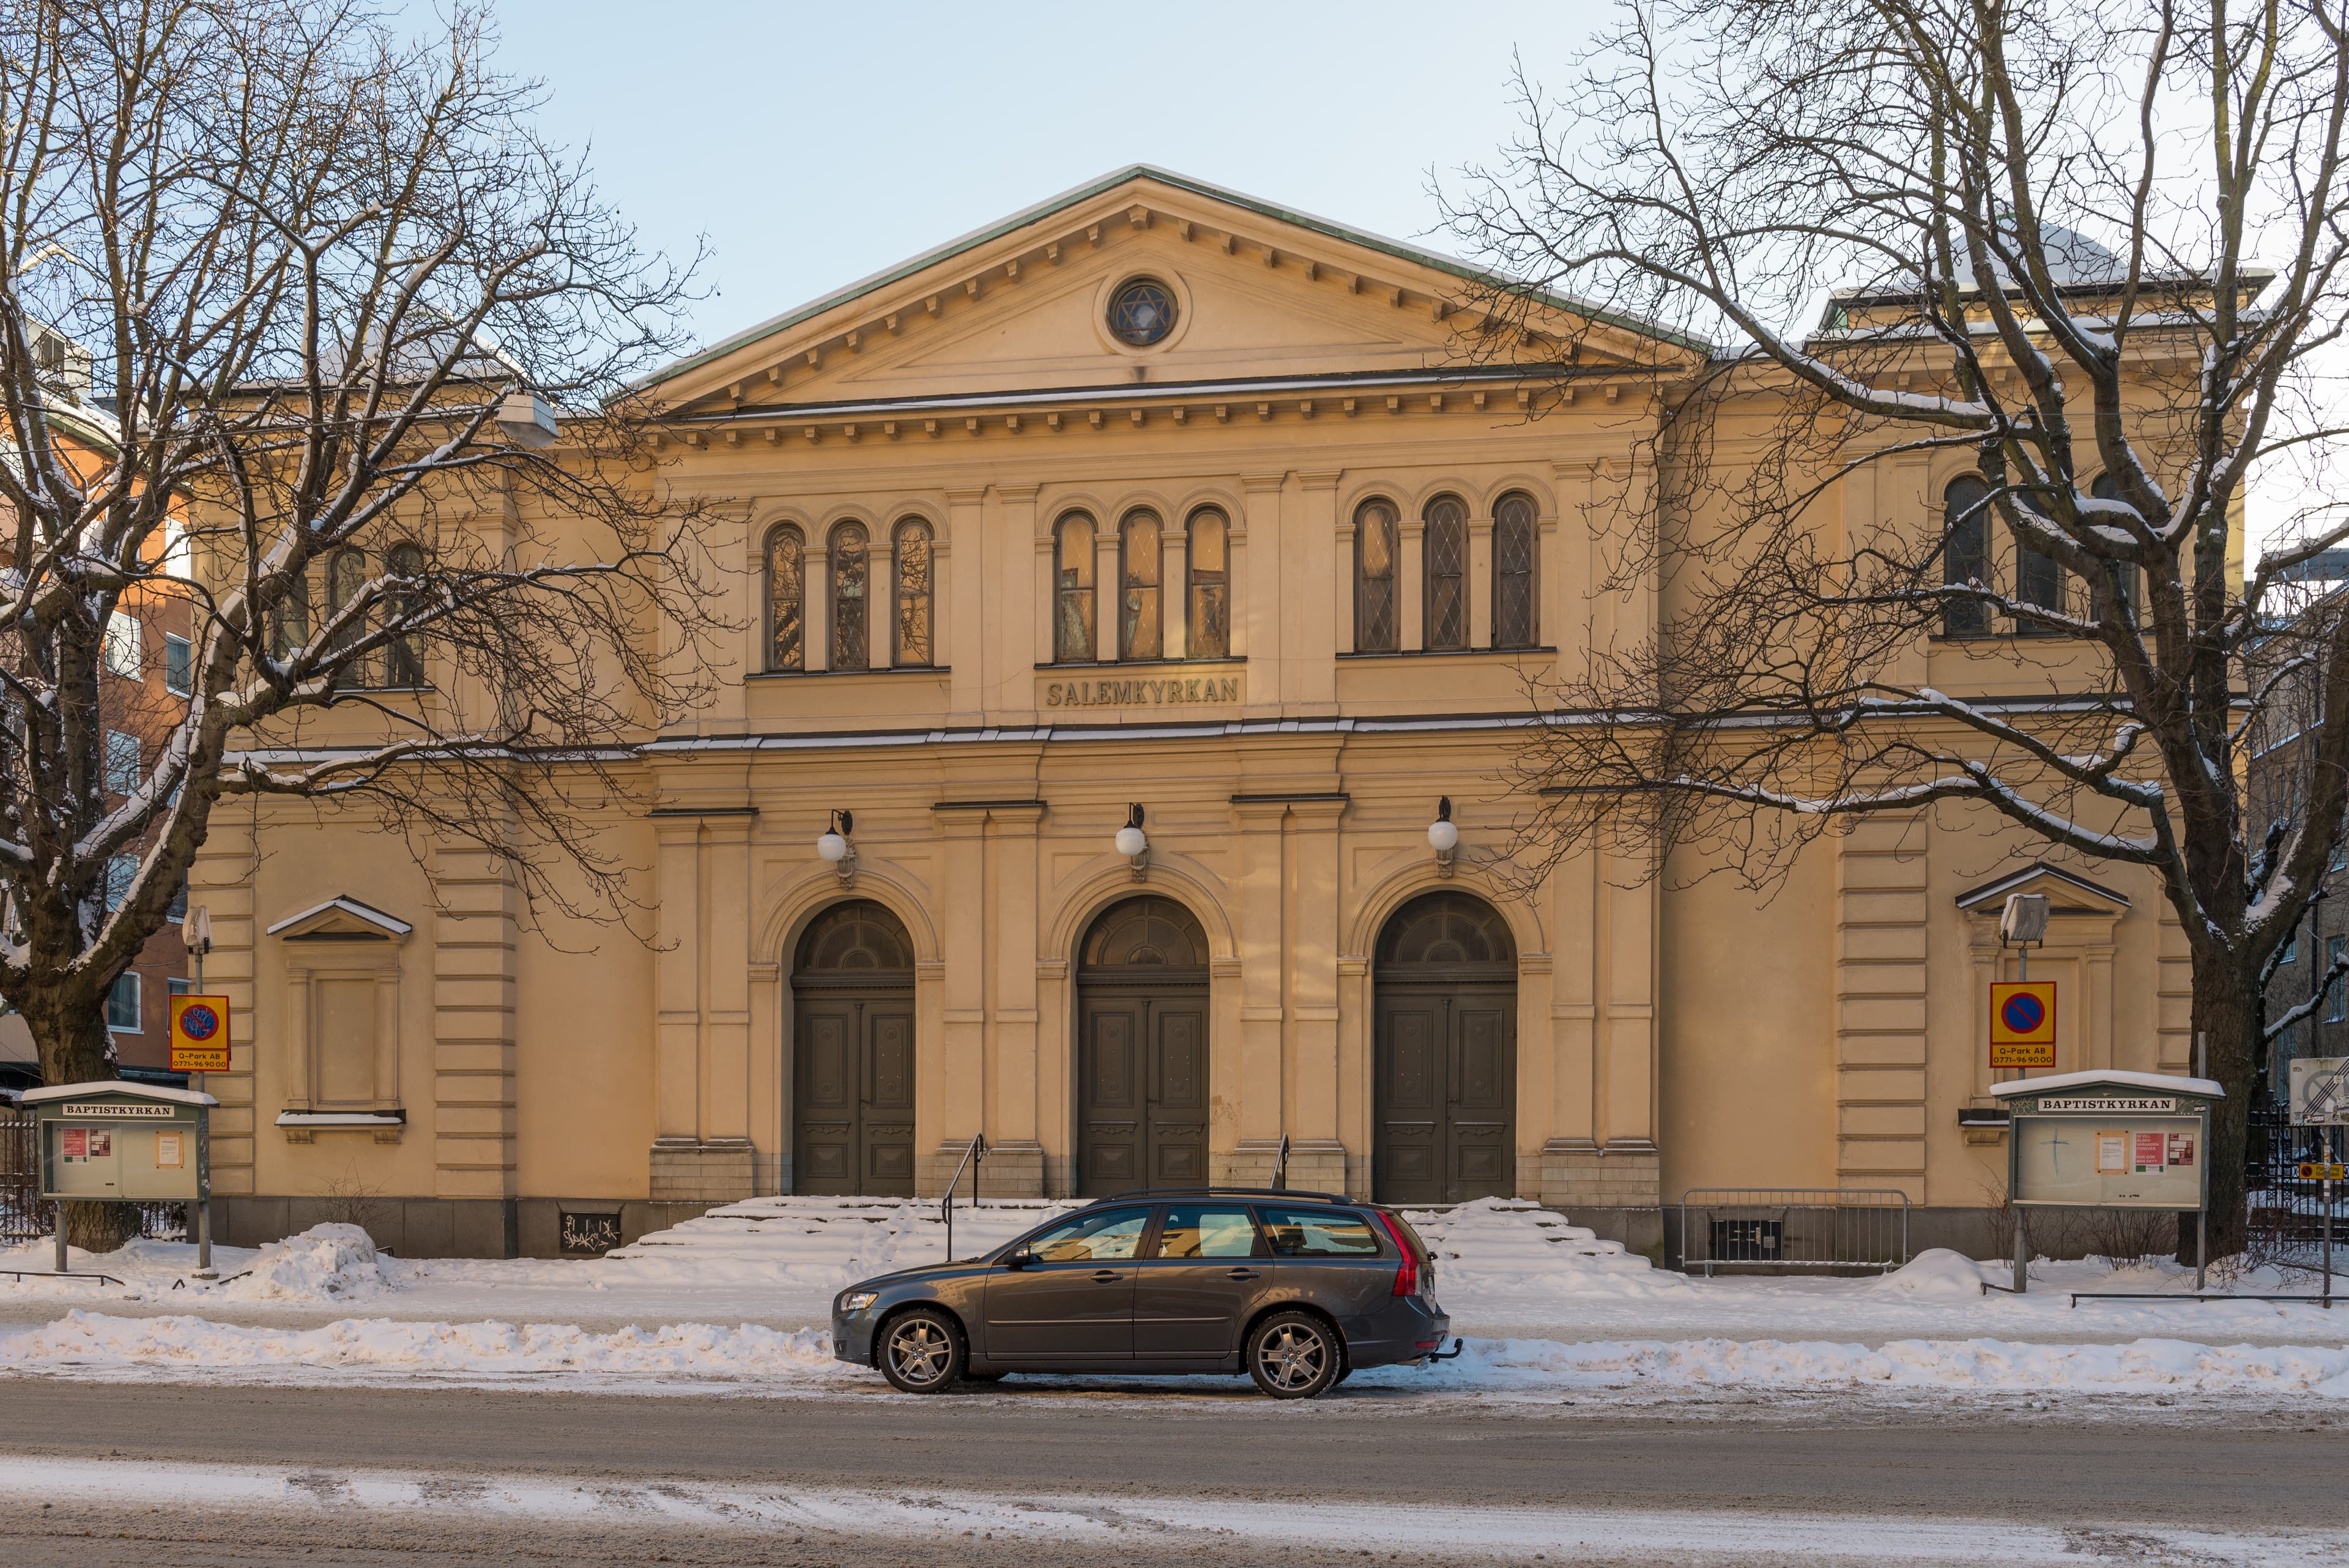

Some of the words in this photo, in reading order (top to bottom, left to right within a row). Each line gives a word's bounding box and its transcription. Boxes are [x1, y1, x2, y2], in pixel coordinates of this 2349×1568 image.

[1047, 677, 1238, 706] SALEMKYRKAN
[2043, 1100, 2171, 1109] BAPTISTKYRKAN
[66, 1105, 171, 1115] BAPTISTKYRKAN
